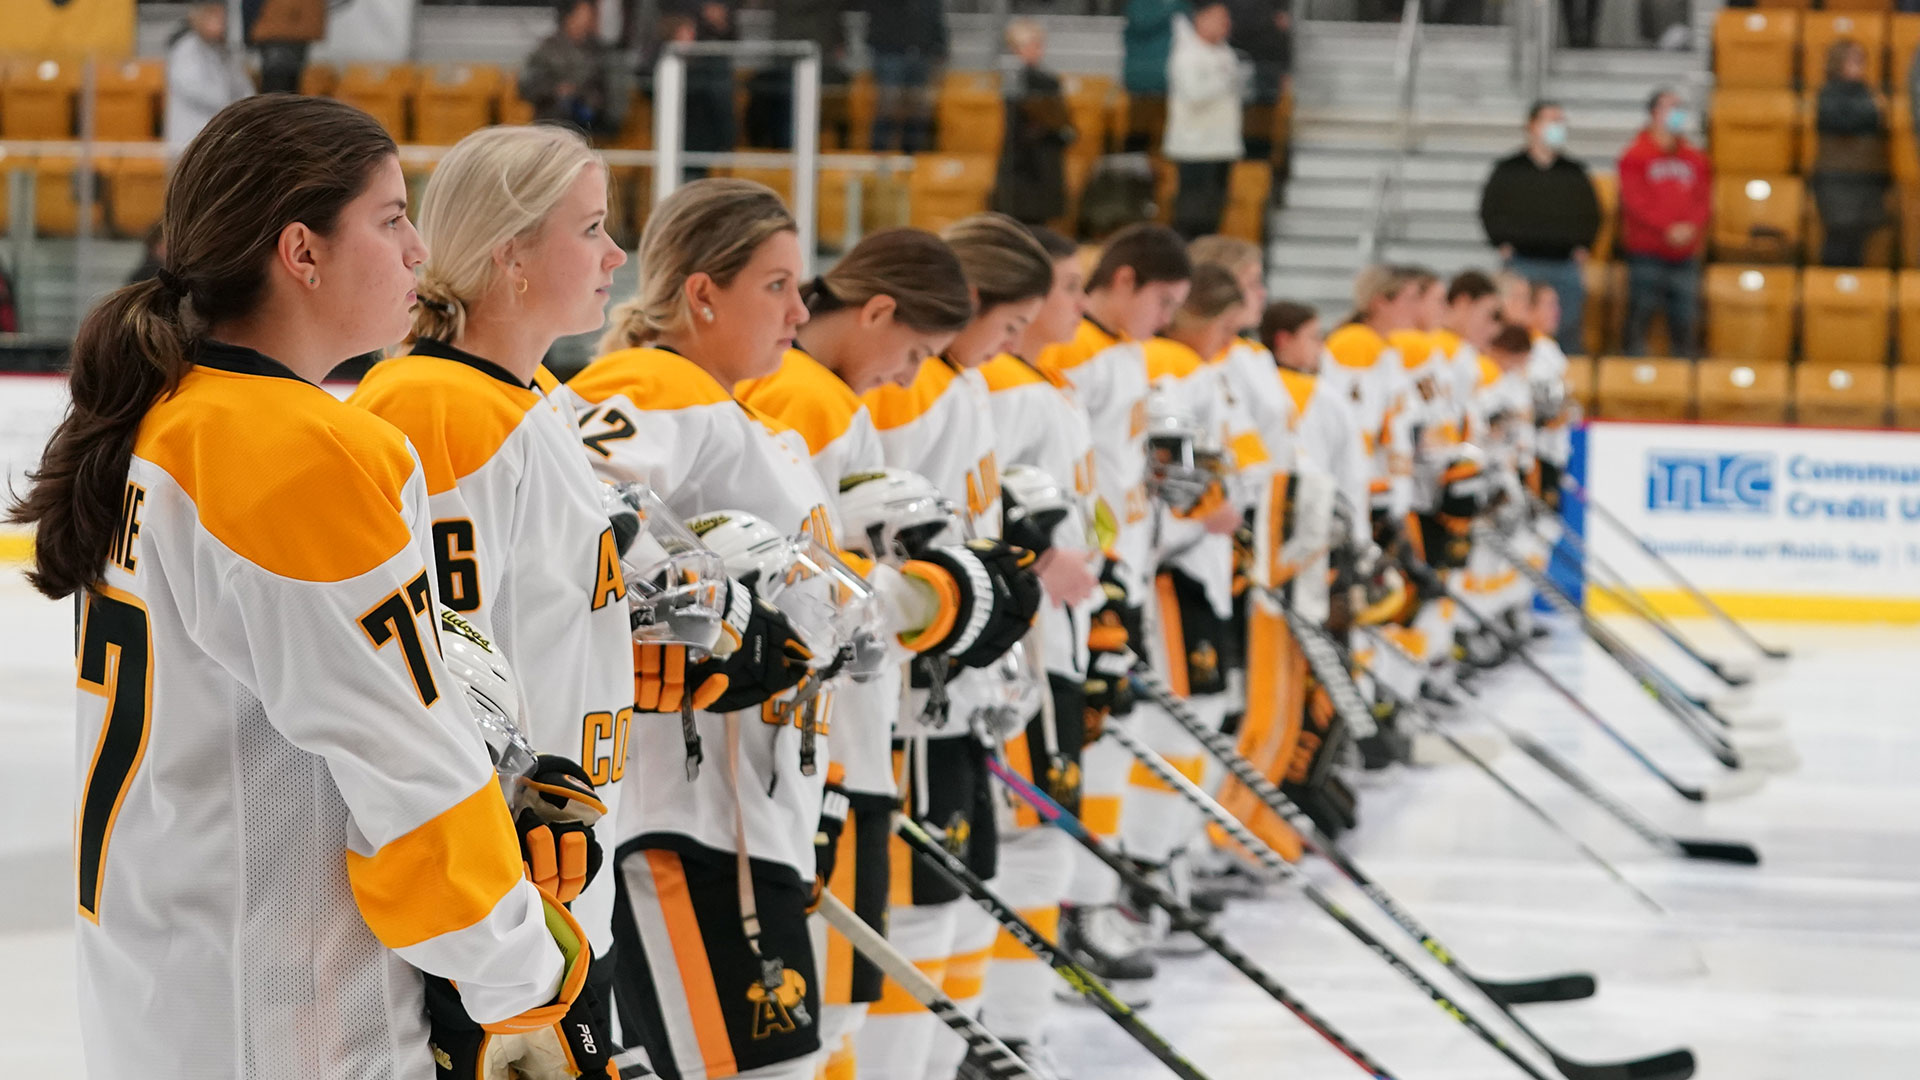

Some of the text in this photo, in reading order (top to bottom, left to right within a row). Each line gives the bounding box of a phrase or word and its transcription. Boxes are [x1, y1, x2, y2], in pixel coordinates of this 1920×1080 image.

[573, 404, 638, 461] 2
[1787, 491, 1885, 521] Credit
[576, 1023, 598, 1055] PRO
